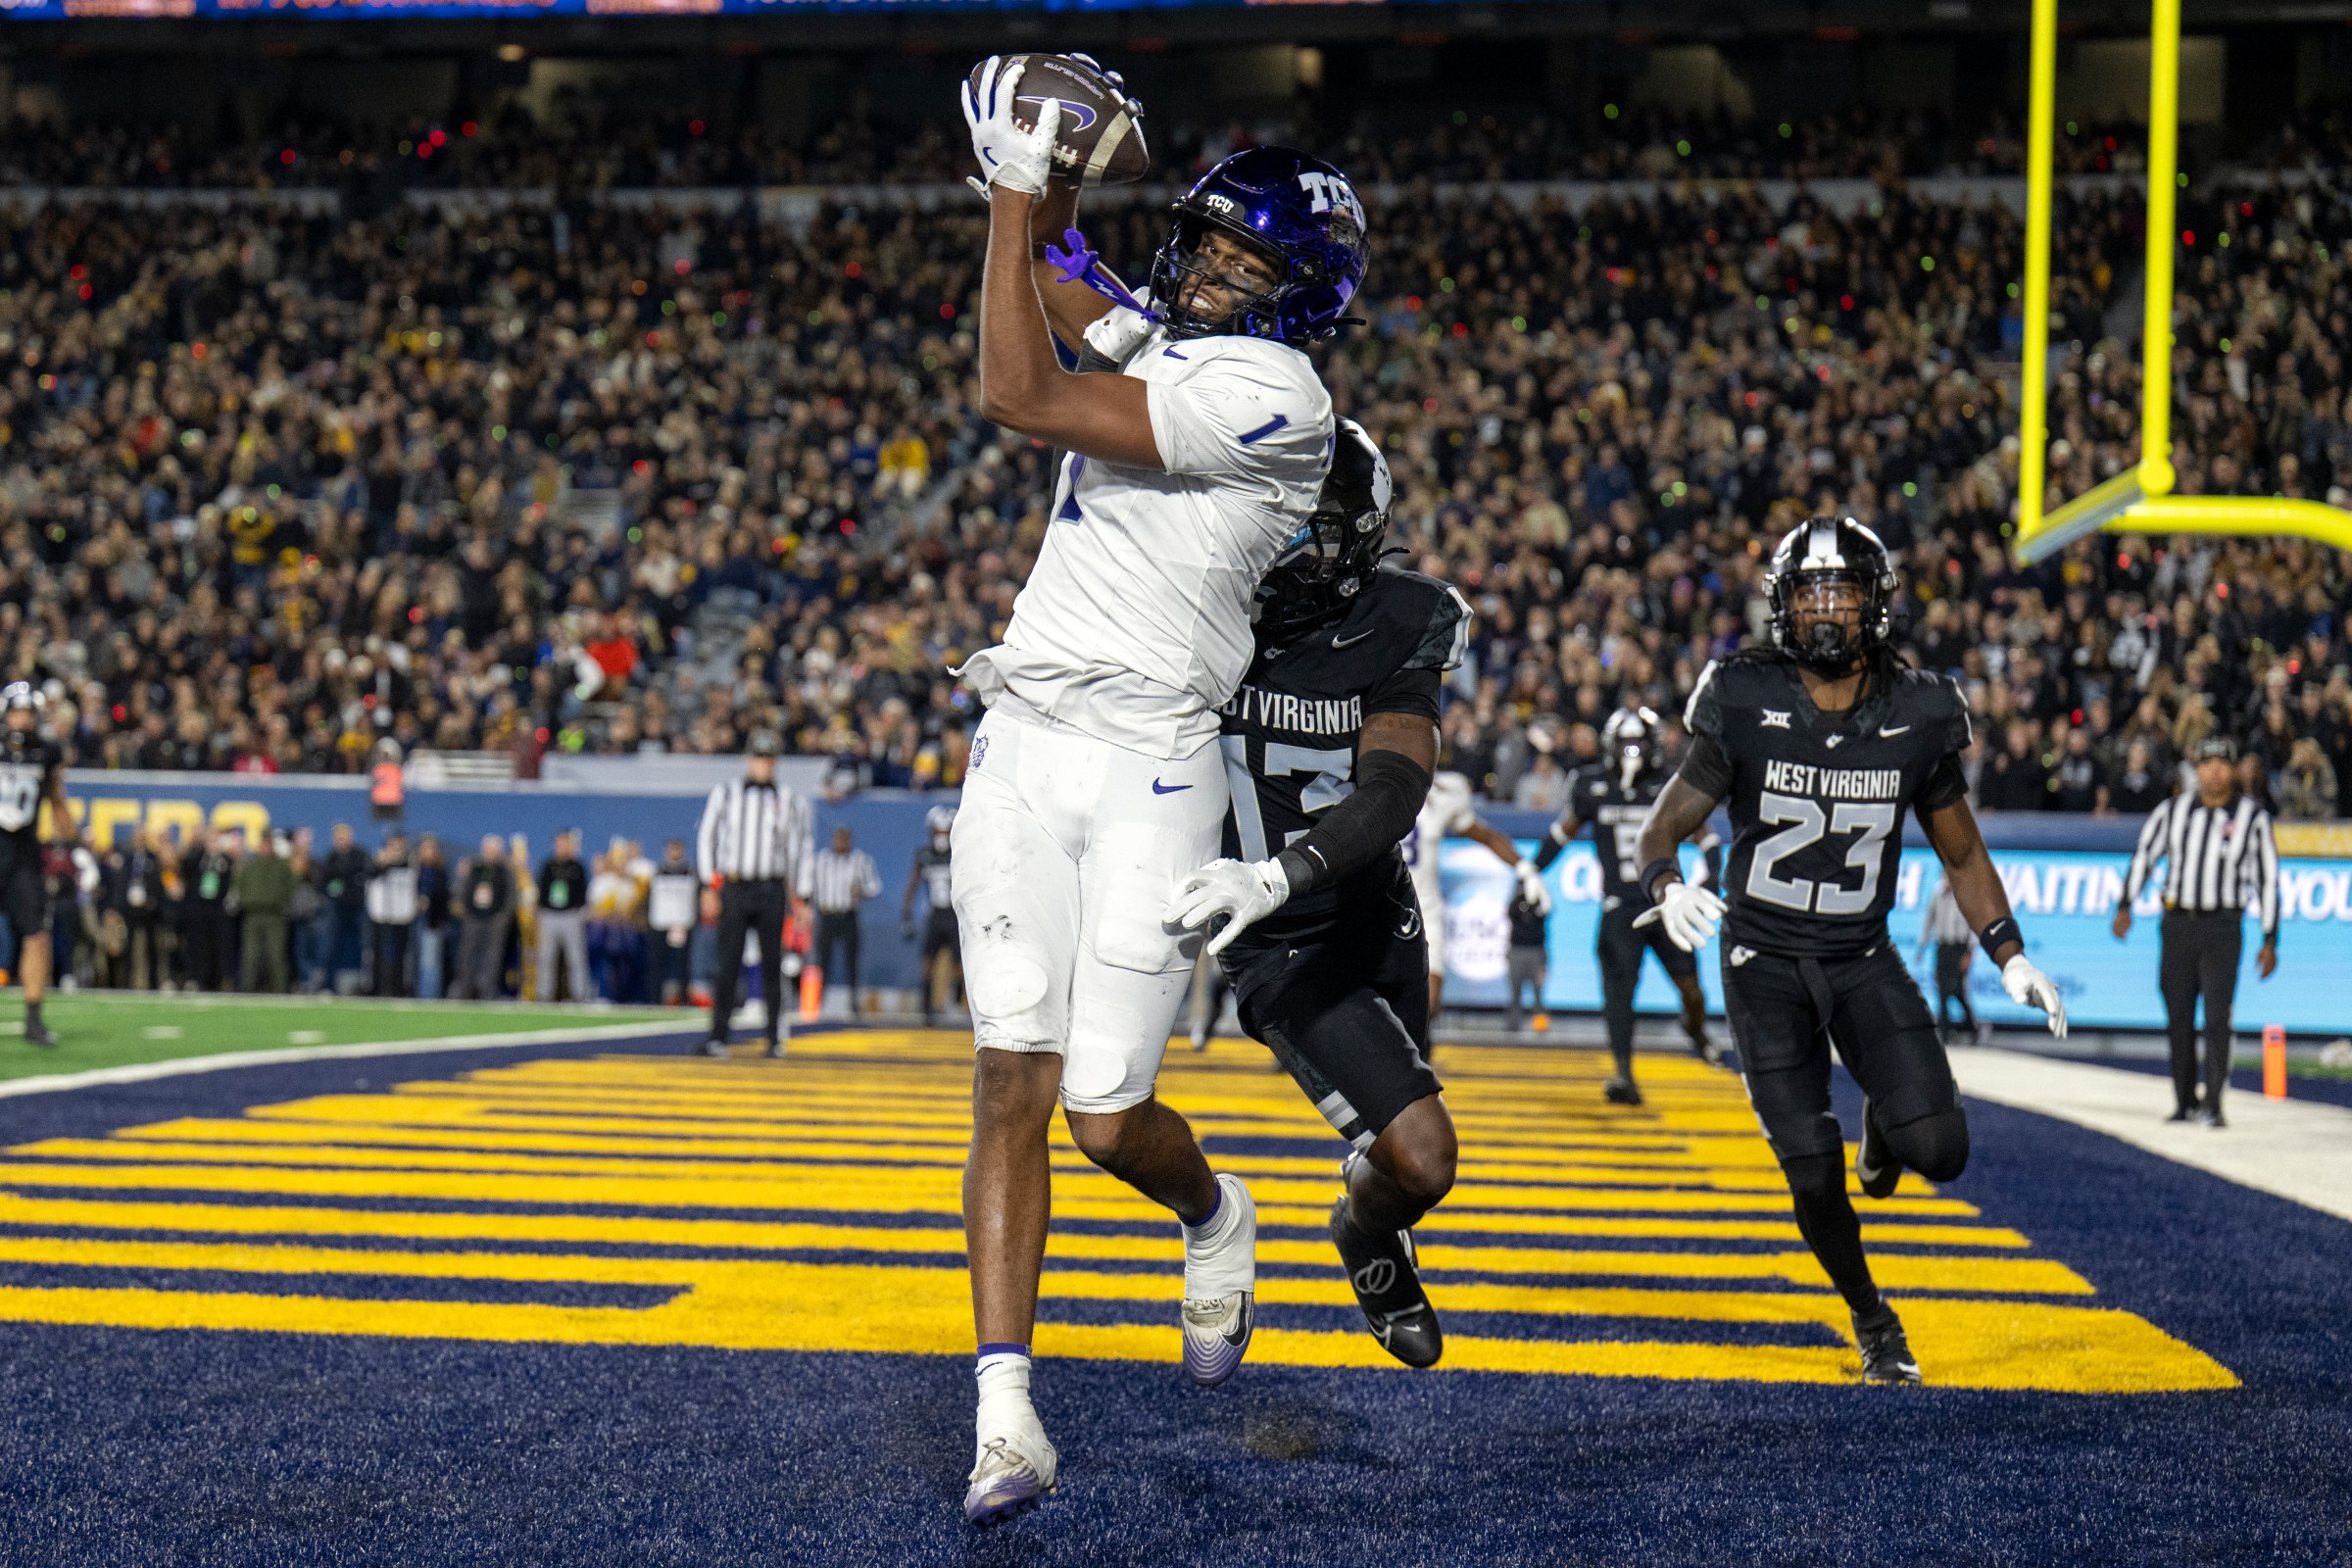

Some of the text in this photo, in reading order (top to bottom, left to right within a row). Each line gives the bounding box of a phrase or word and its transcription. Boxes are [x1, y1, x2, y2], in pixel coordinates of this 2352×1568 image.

[1206, 194, 1235, 214] TCU
[1237, 414, 1291, 445] 1
[1258, 690, 1363, 735] VIRGINIA
[1765, 759, 1901, 799] WEST VIRGINIA
[1745, 790, 1897, 915] 23
